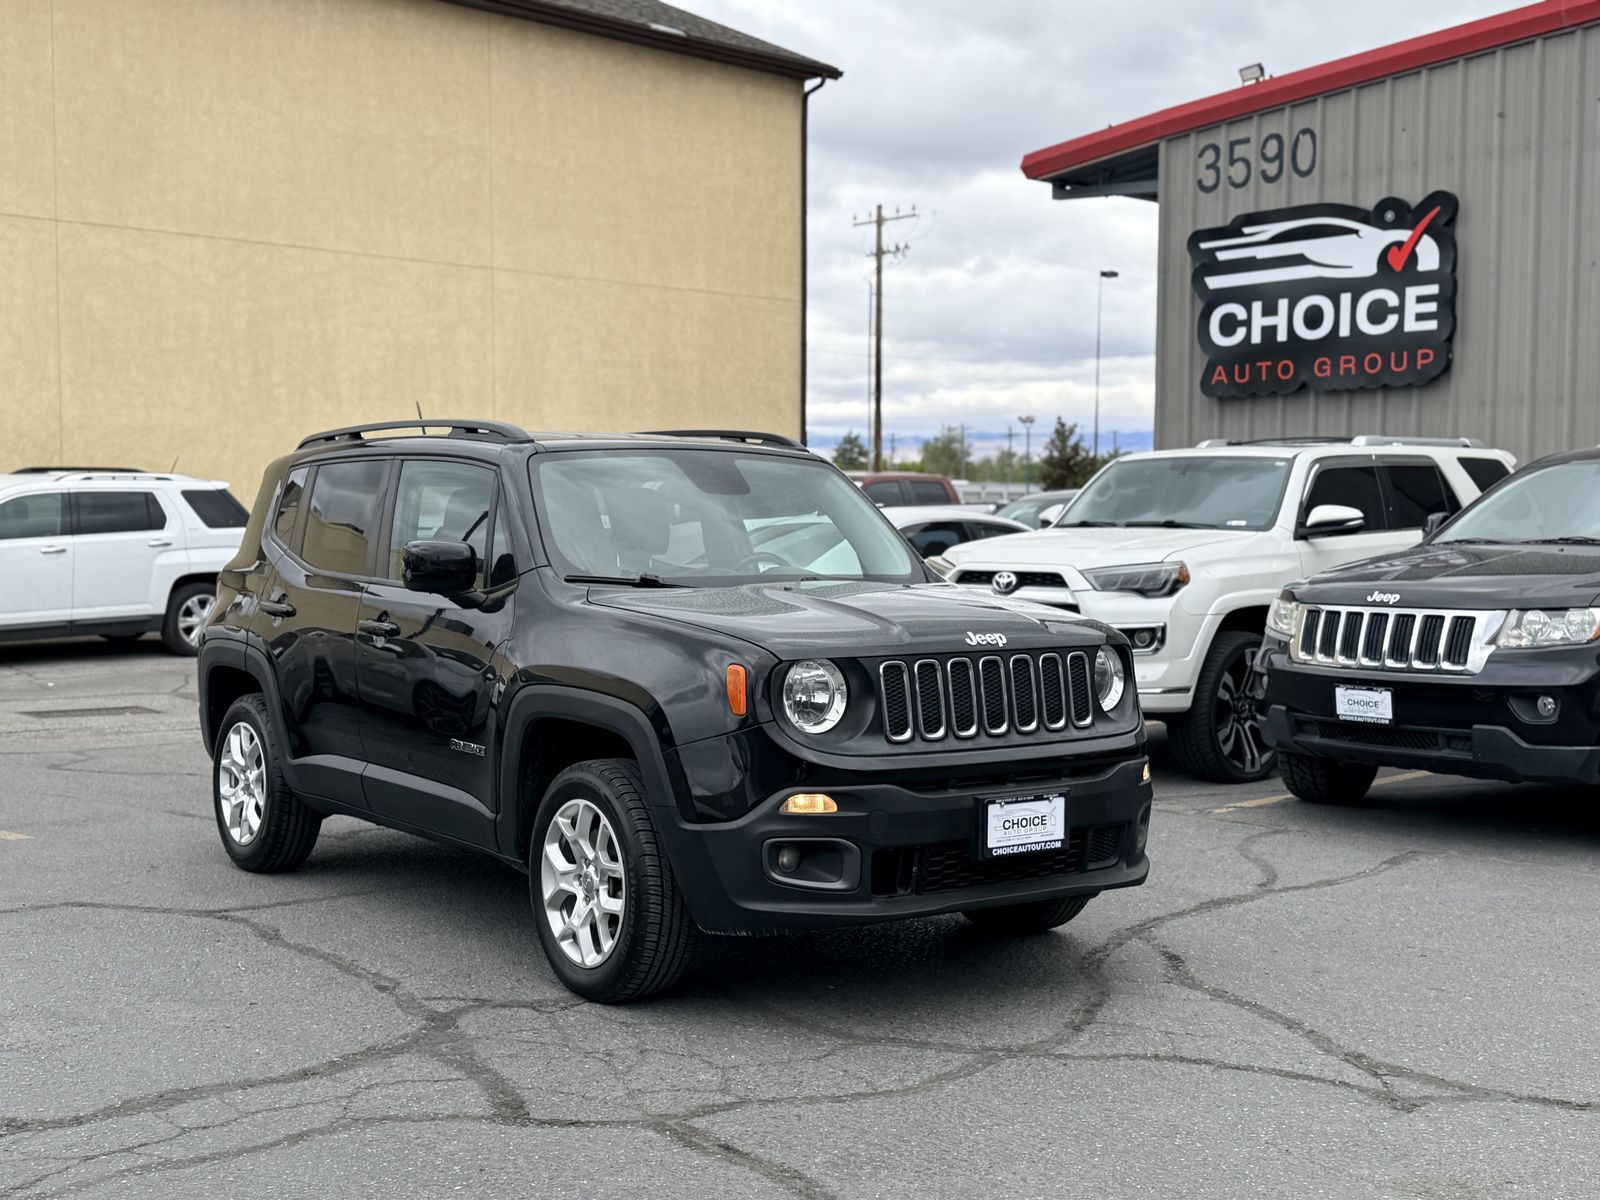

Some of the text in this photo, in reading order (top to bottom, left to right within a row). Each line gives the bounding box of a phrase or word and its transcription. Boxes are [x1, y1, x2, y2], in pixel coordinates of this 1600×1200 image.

[1196, 127, 1317, 193] 3590
[1209, 283, 1440, 347] CHOICE
[1211, 348, 1435, 385] AUTO GROUP
[1366, 590, 1401, 605] Jeep
[965, 631, 1007, 648] Jeep
[1347, 698, 1380, 709] CHOICE
[1003, 815, 1047, 830] CHOICE
[1024, 826, 1047, 834] GROUP
[992, 841, 1062, 856] CHOICEAUTOUT.COM
